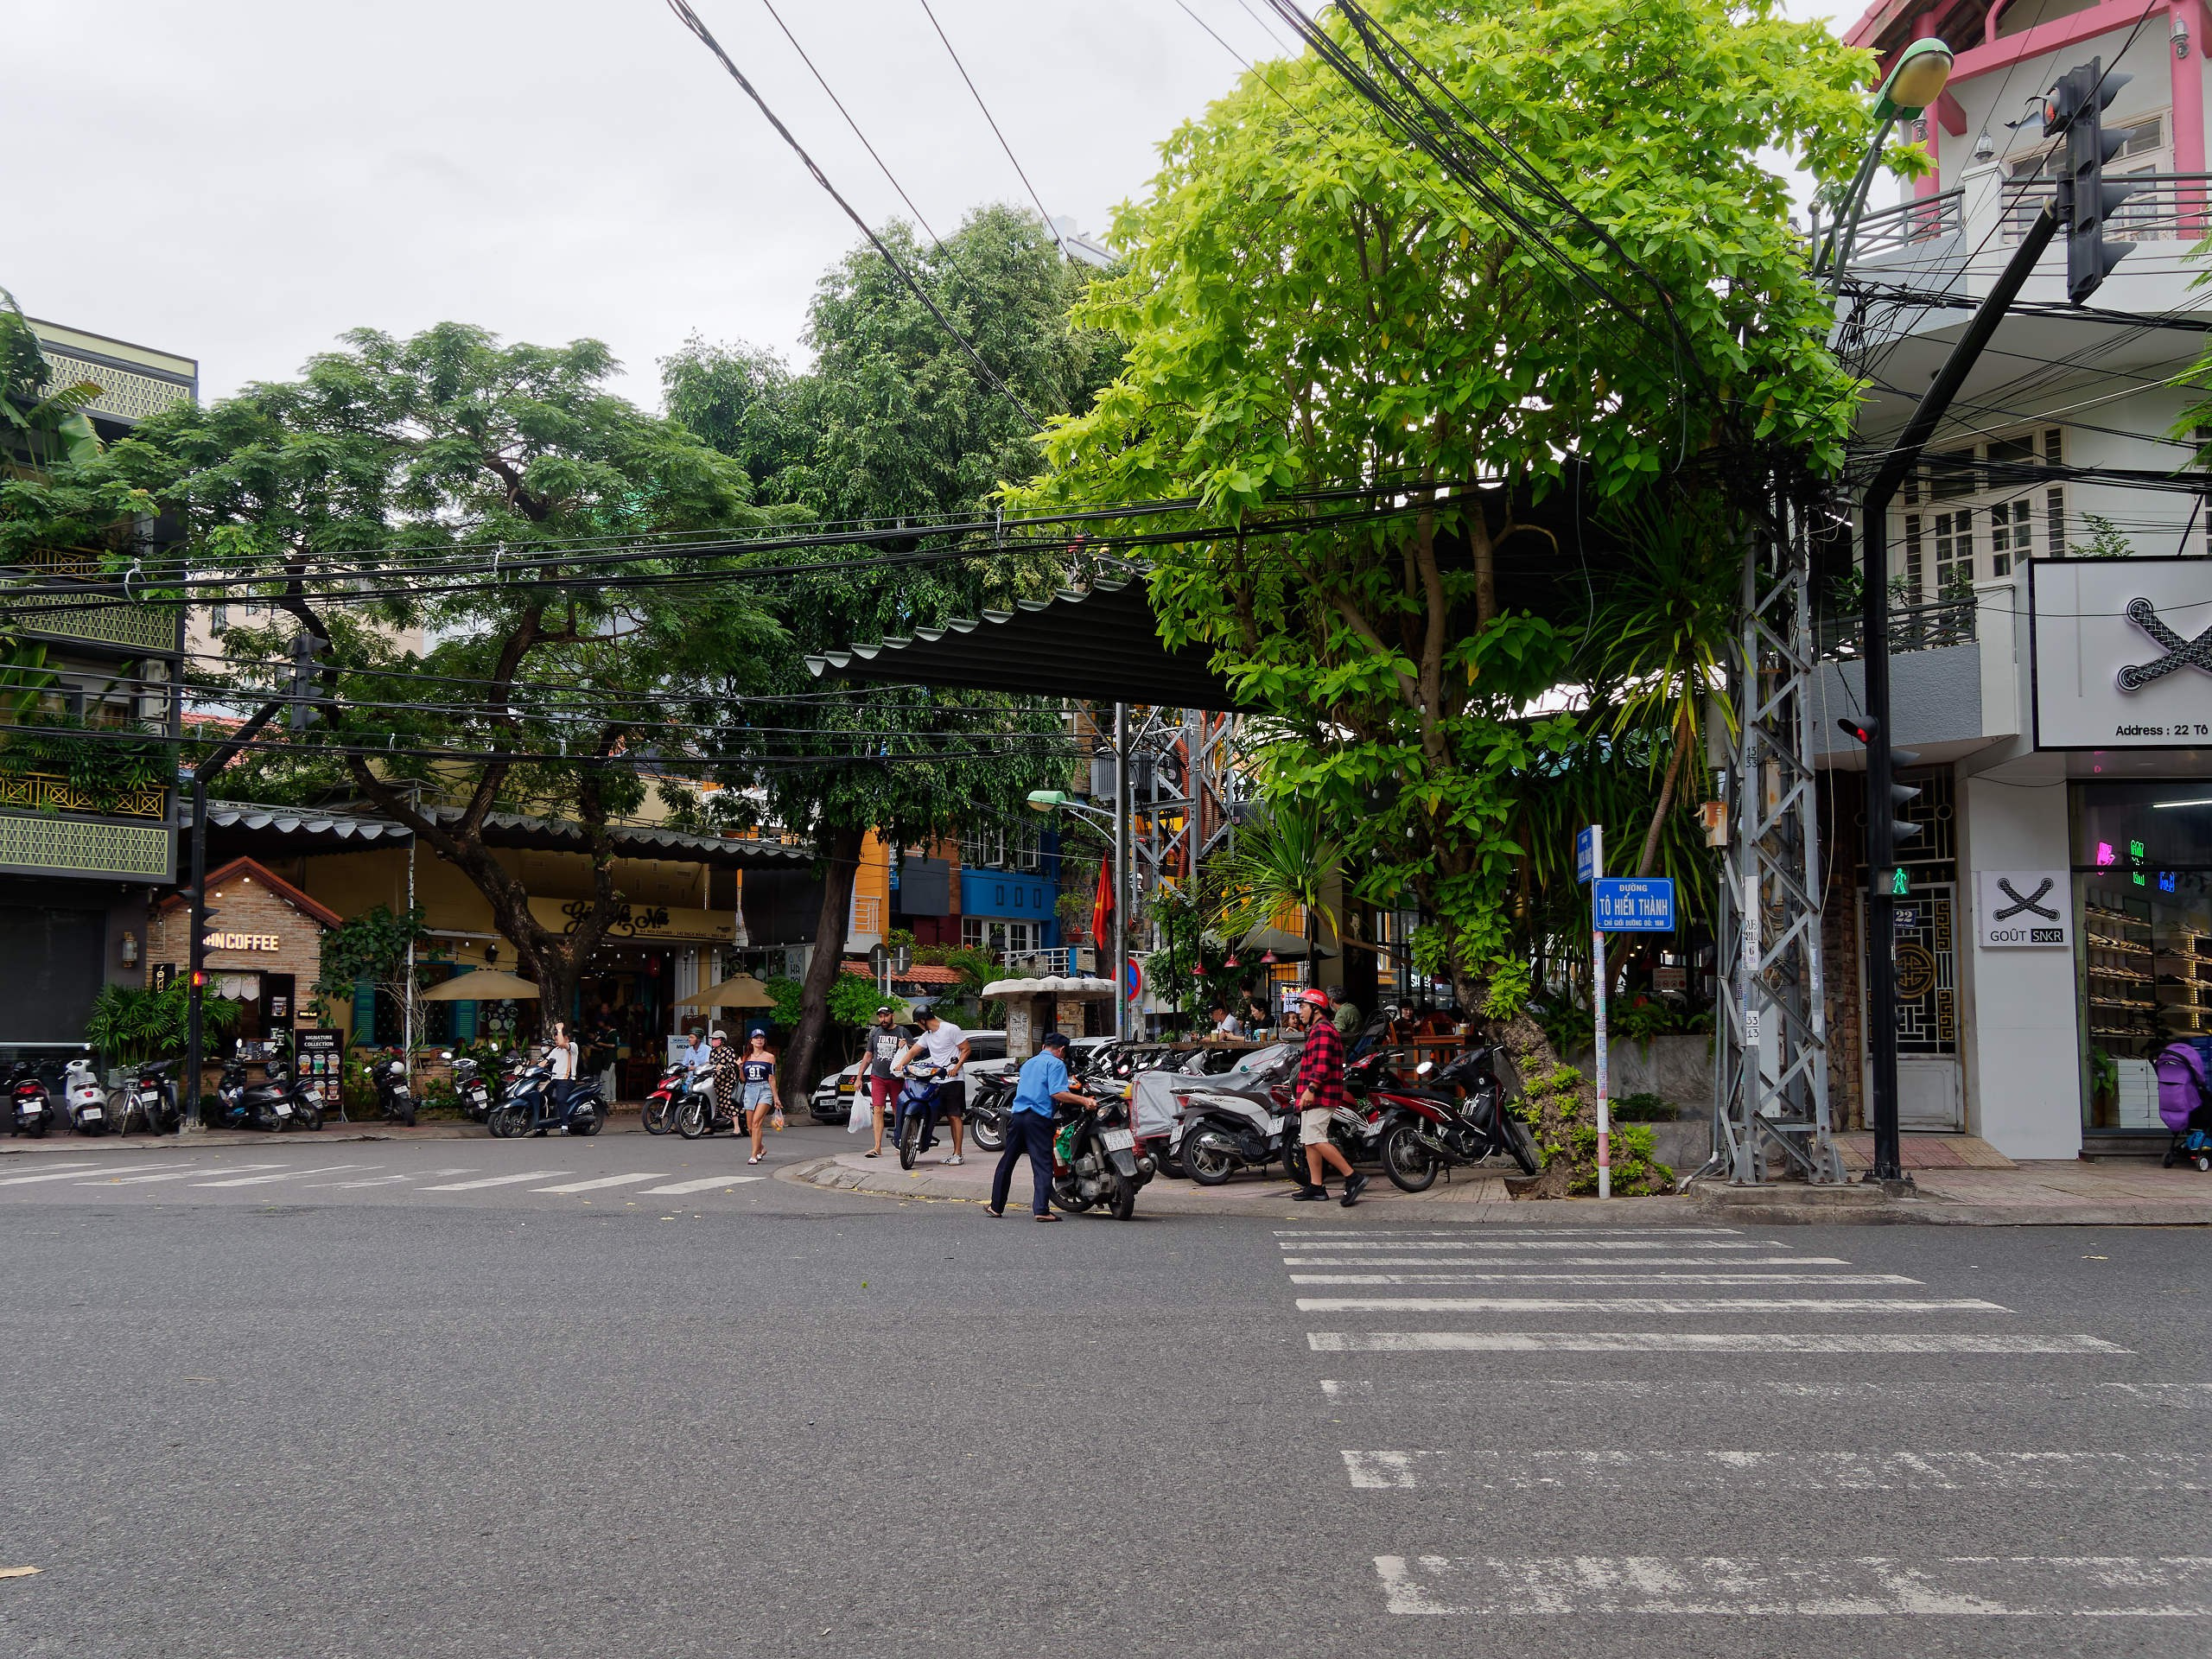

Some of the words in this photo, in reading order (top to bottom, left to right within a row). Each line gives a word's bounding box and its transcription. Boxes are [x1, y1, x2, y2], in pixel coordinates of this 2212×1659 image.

[2115, 724, 2164, 736] Address
[2174, 724, 2190, 735] 22
[2193, 724, 2209, 735] Tô
[1618, 882, 1648, 892] ĐƯỜNG
[1599, 894, 1611, 916] TÔ
[1614, 892, 1635, 916] HIẾN
[1638, 894, 1668, 916] THÀNH
[1895, 910, 1913, 923] 22
[1990, 928, 2027, 942] GOÛT
[2032, 931, 2062, 942] SNKR
[203, 932, 225, 949] HN
[226, 933, 279, 951] COFFEE
[1745, 1016, 1758, 1026] 33
[1746, 1029, 1759, 1039] 13
[878, 1035, 898, 1045] TOKYO
[748, 1067, 761, 1077] 91
